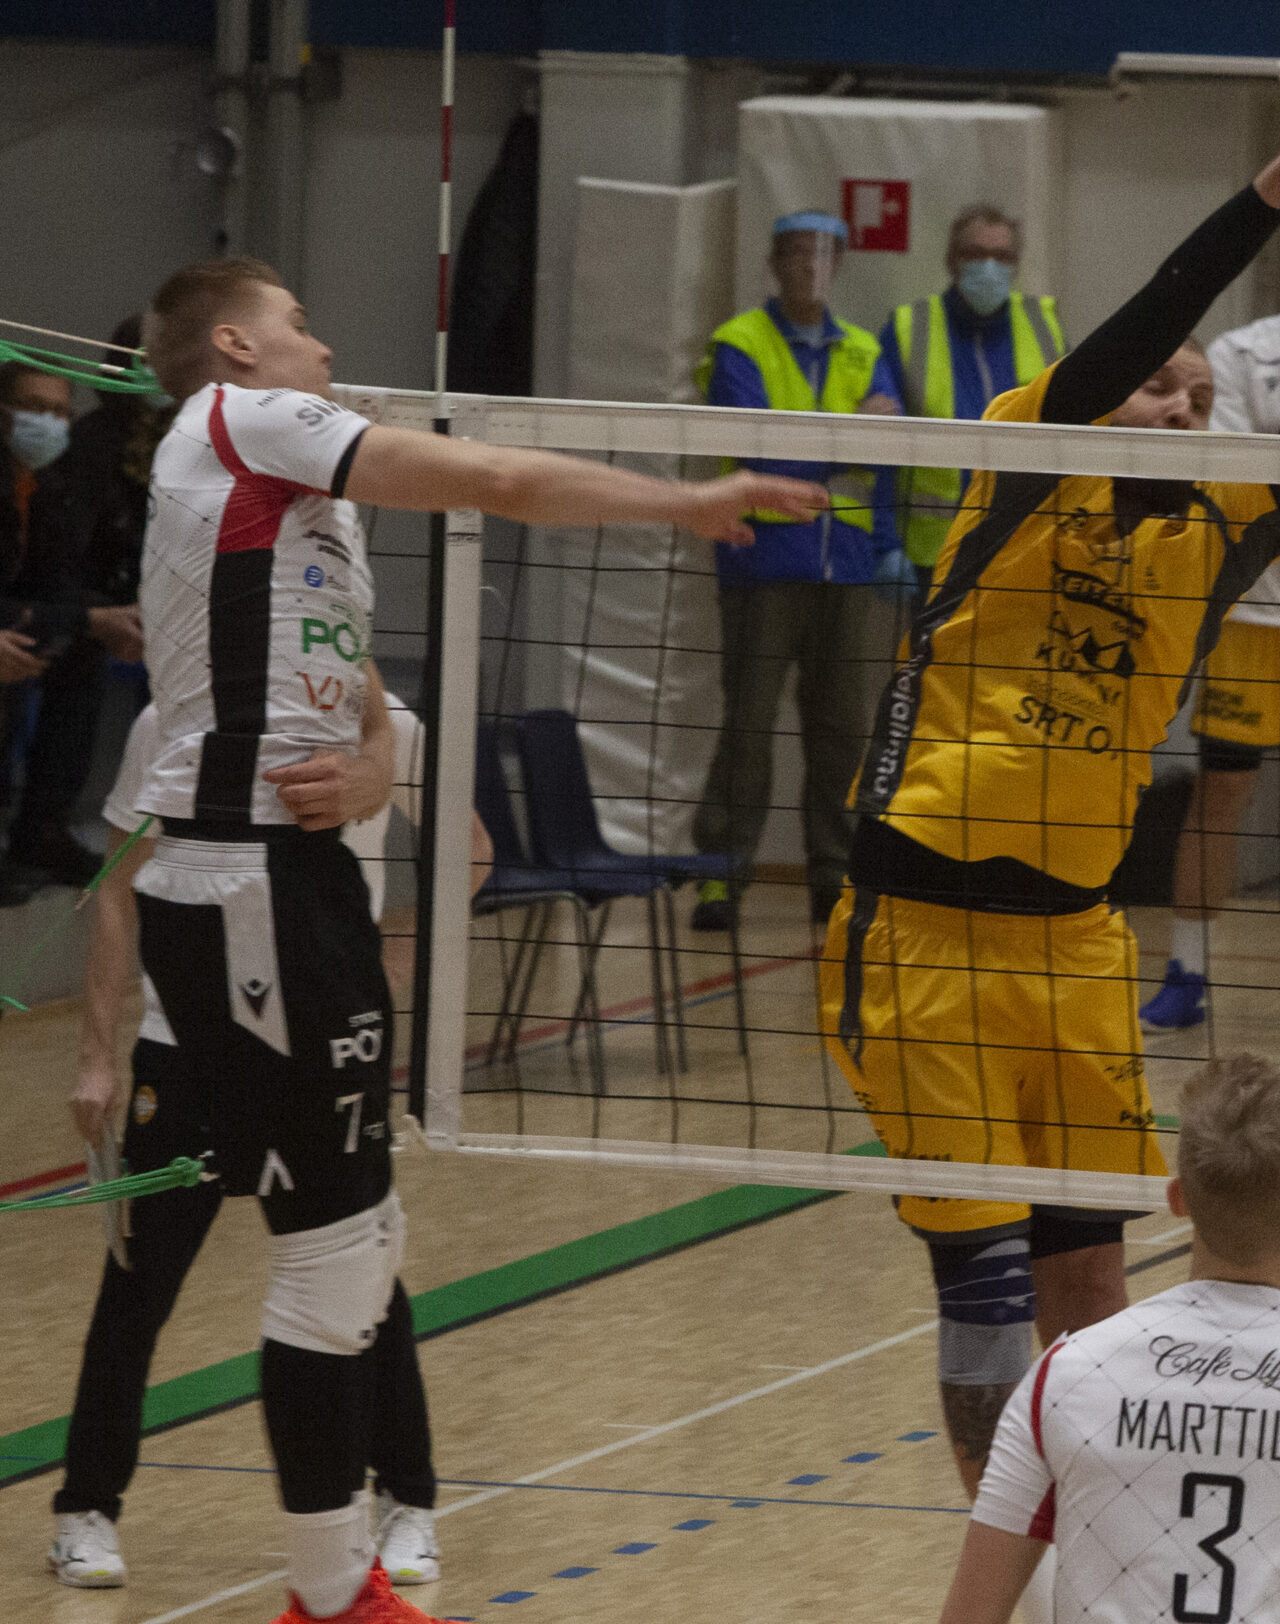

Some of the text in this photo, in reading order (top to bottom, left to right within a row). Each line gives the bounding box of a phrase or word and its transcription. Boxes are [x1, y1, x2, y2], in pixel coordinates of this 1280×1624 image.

[335, 1092, 365, 1153] 7
[1149, 1335, 1232, 1386] Café
[1173, 1472, 1245, 1624] 3
